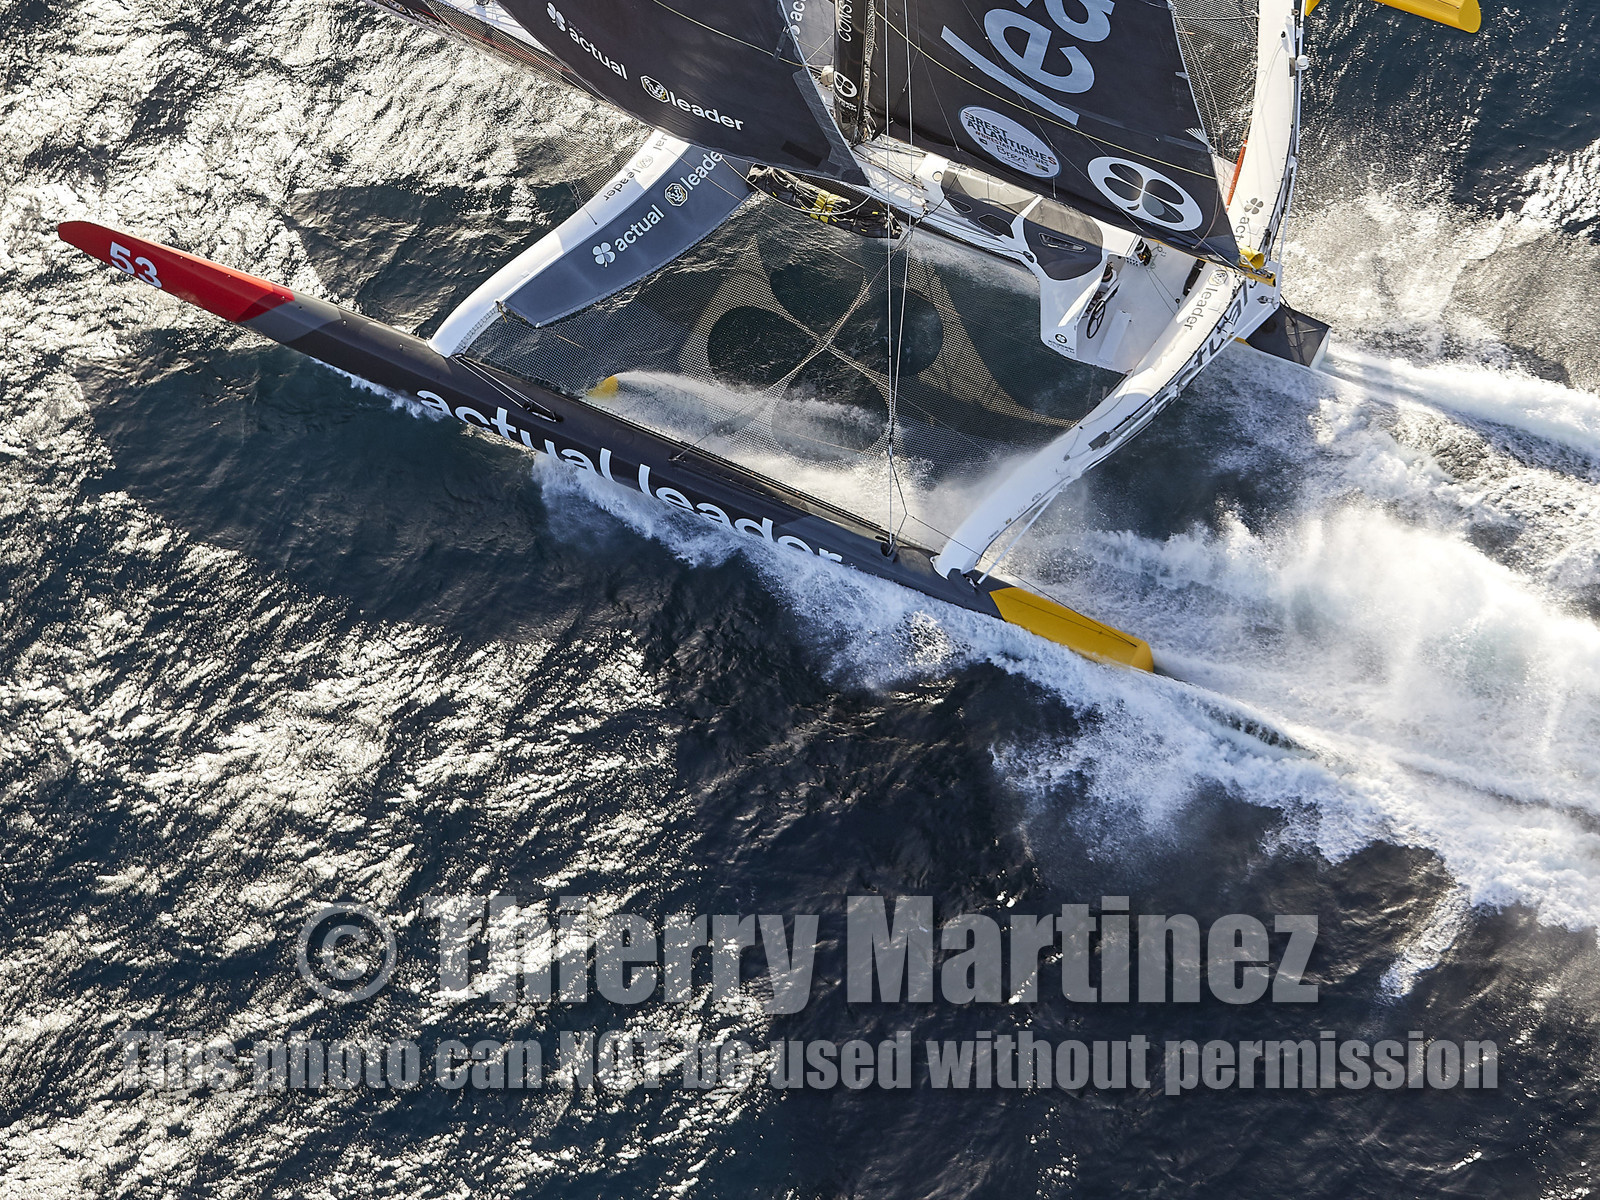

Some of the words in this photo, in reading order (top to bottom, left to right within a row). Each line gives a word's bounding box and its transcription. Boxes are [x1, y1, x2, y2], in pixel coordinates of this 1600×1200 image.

[568, 26, 628, 81] actual
[669, 90, 744, 131] leader
[963, 110, 1008, 137] BREST
[967, 120, 1057, 166] ATLANTIQUES
[614, 204, 665, 252] actual
[109, 241, 163, 289] 53
[1184, 286, 1218, 331] leader
[416, 390, 616, 482] actual
